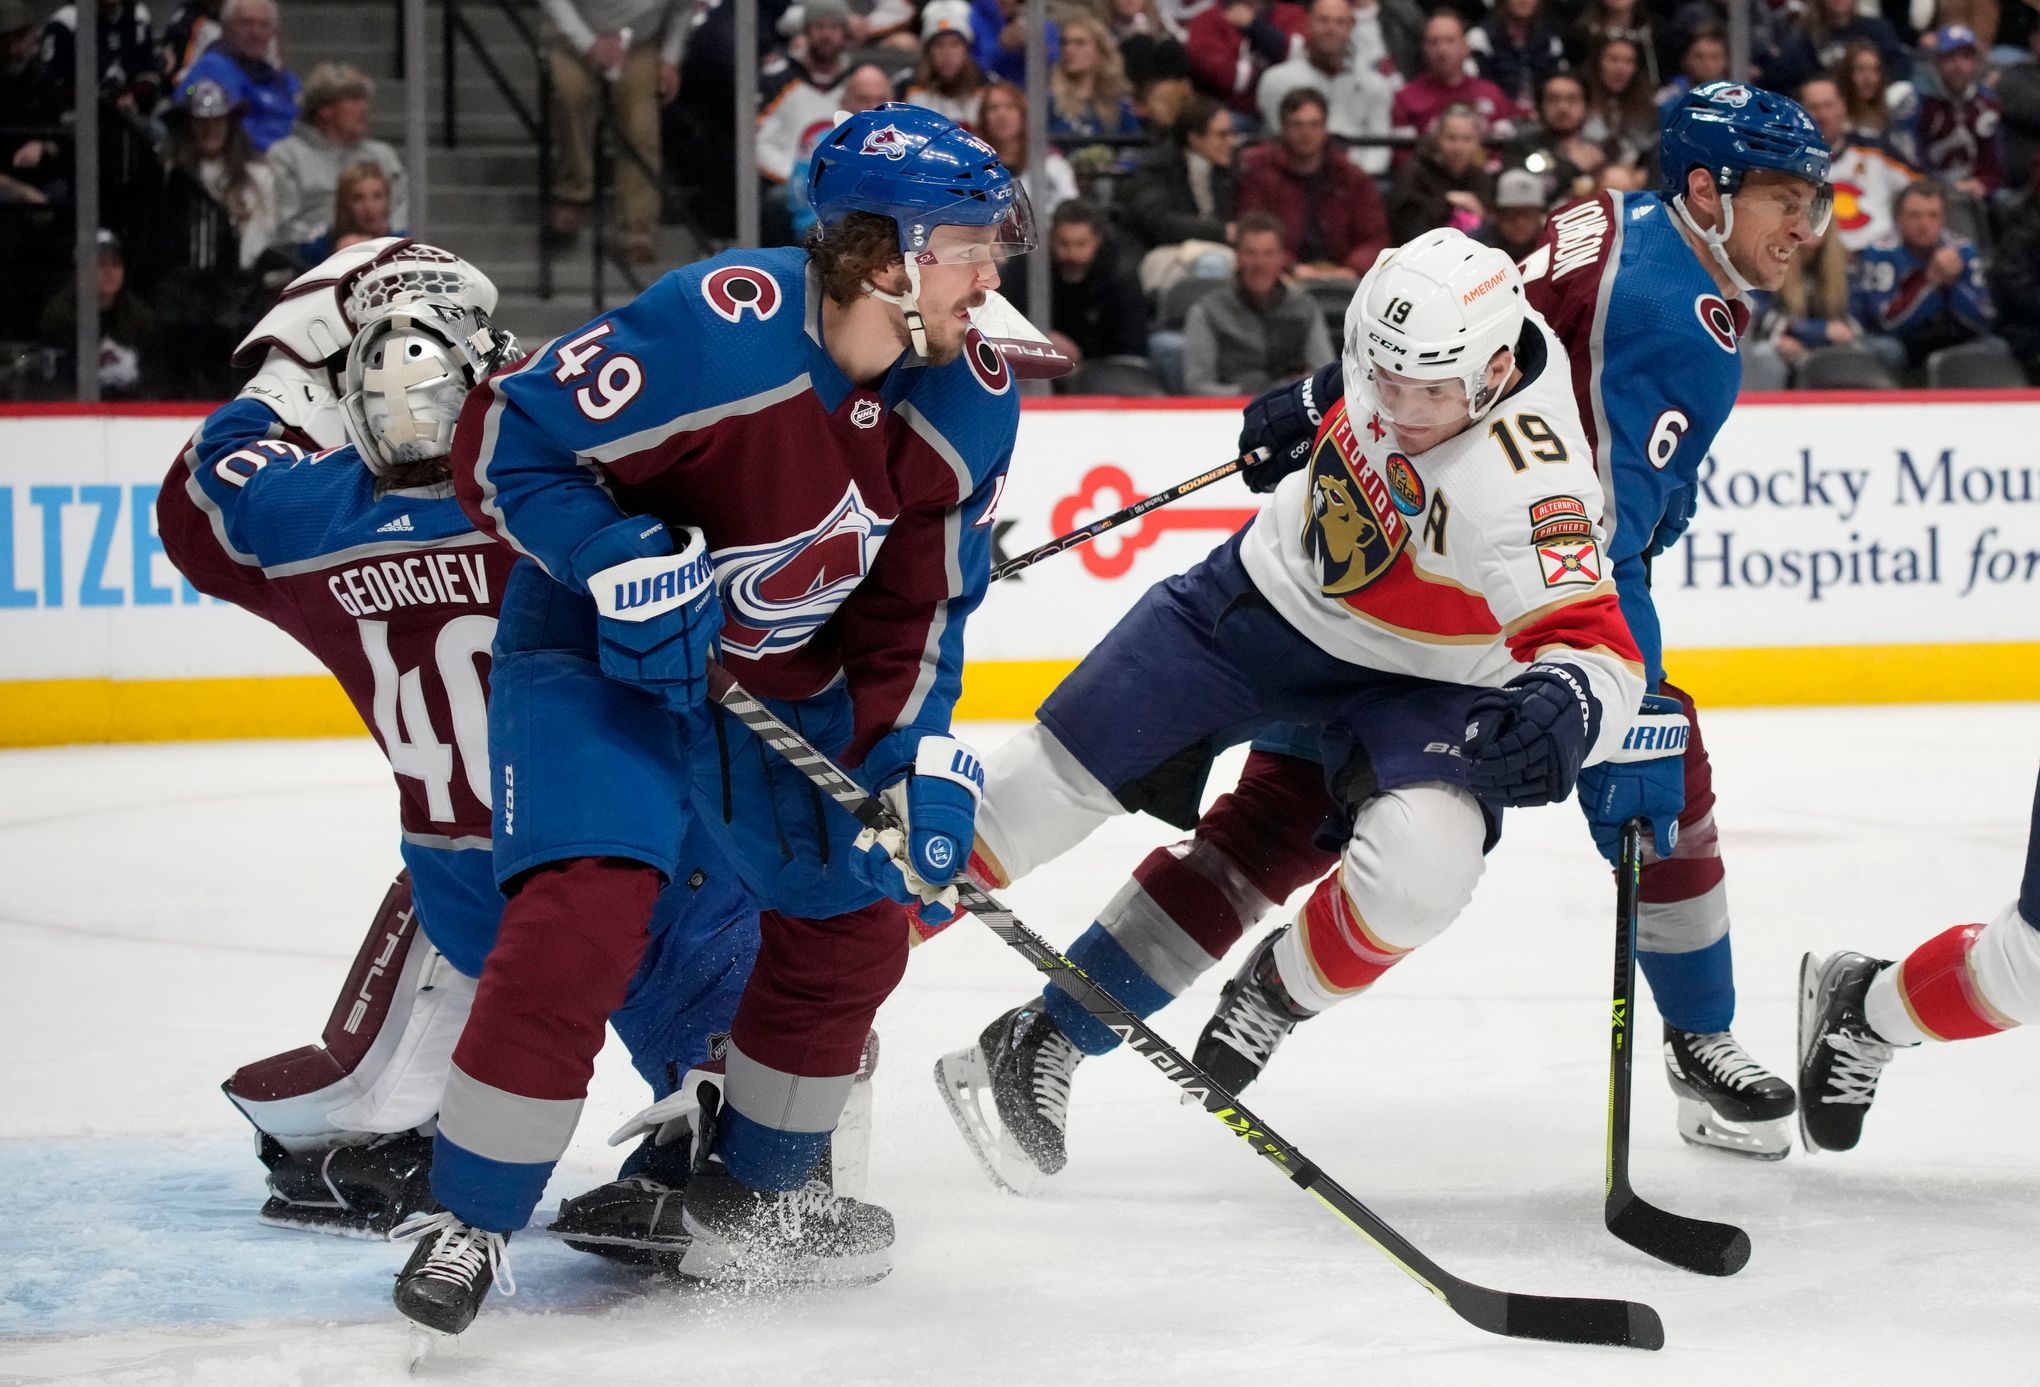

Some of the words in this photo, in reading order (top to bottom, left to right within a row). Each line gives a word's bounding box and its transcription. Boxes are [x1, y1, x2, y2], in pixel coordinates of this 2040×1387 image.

[1384, 297, 1413, 325] 19
[1463, 268, 1508, 305] AMERANT
[554, 321, 645, 421] 49
[1368, 332, 1408, 355] CCM
[855, 409, 875, 421] NHL
[1489, 413, 1569, 474] 19
[1645, 407, 1690, 471] 6
[1178, 462, 1237, 495] SHERWOOD
[1336, 421, 1398, 535] FLORIDA
[1539, 501, 1580, 515] ALTERNATE
[1697, 448, 1871, 521] Rocky
[0, 485, 235, 609] LTZE
[377, 525, 415, 533] adidas
[1423, 487, 1449, 558] A
[1541, 523, 1584, 537] PANTHERS
[328, 553, 490, 617] GEORGIEV
[1681, 526, 1941, 602] Hospital
[356, 614, 500, 824] 40
[505, 764, 514, 833] CCM
[343, 905, 416, 1035] TRUE
